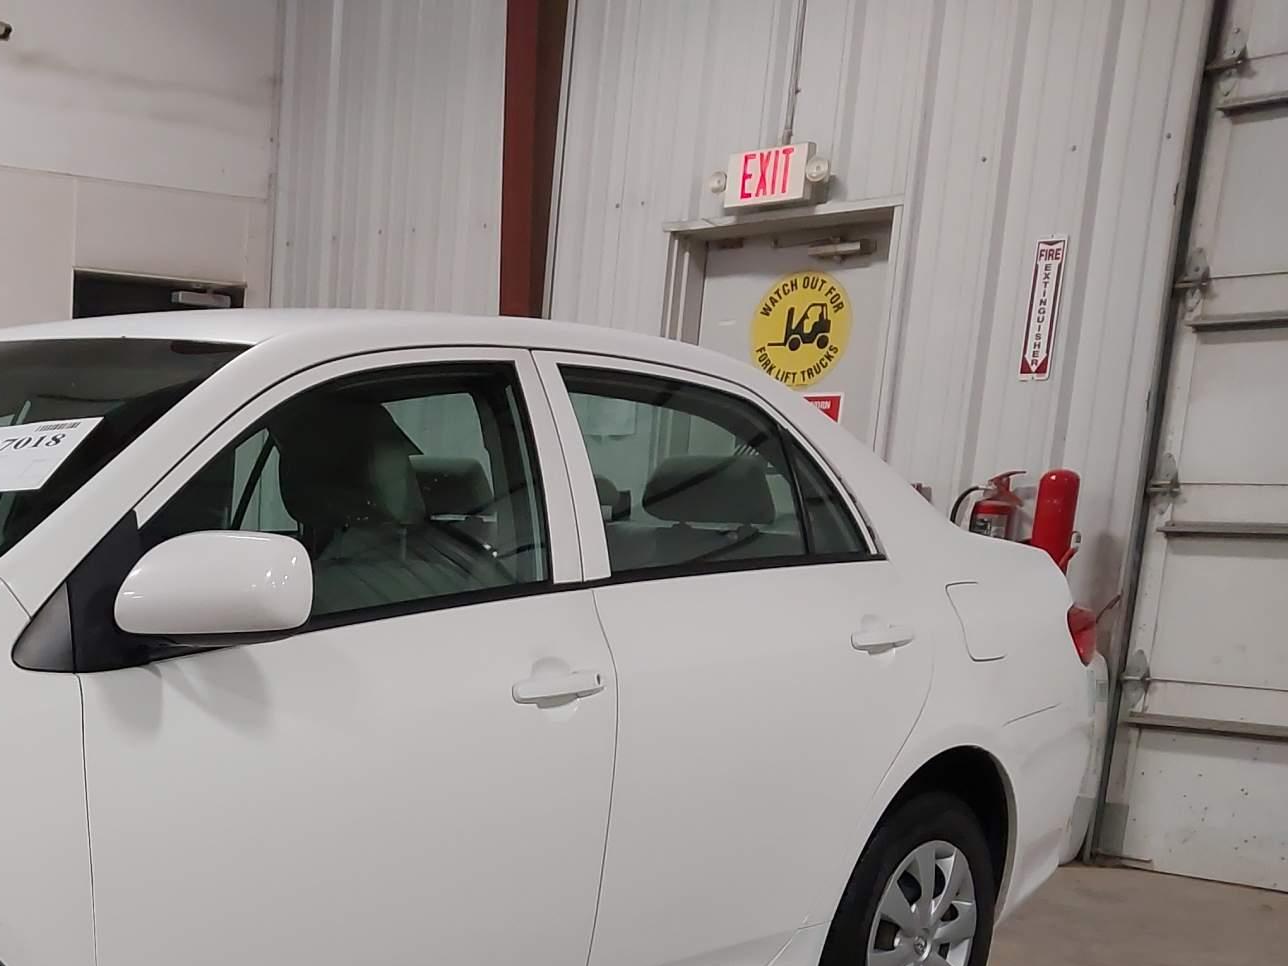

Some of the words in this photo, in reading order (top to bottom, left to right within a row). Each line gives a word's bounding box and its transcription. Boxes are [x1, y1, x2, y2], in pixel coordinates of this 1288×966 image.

[740, 148, 794, 200] EXIT
[1038, 248, 1062, 261] FIRE
[760, 278, 798, 317] WATCH
[802, 276, 827, 292] OUT
[824, 286, 845, 313] FOR
[1031, 263, 1052, 367] EXTINGUISHER
[756, 346, 777, 376] FORK
[775, 368, 797, 384] LIFT
[800, 344, 839, 382] TRUCKS
